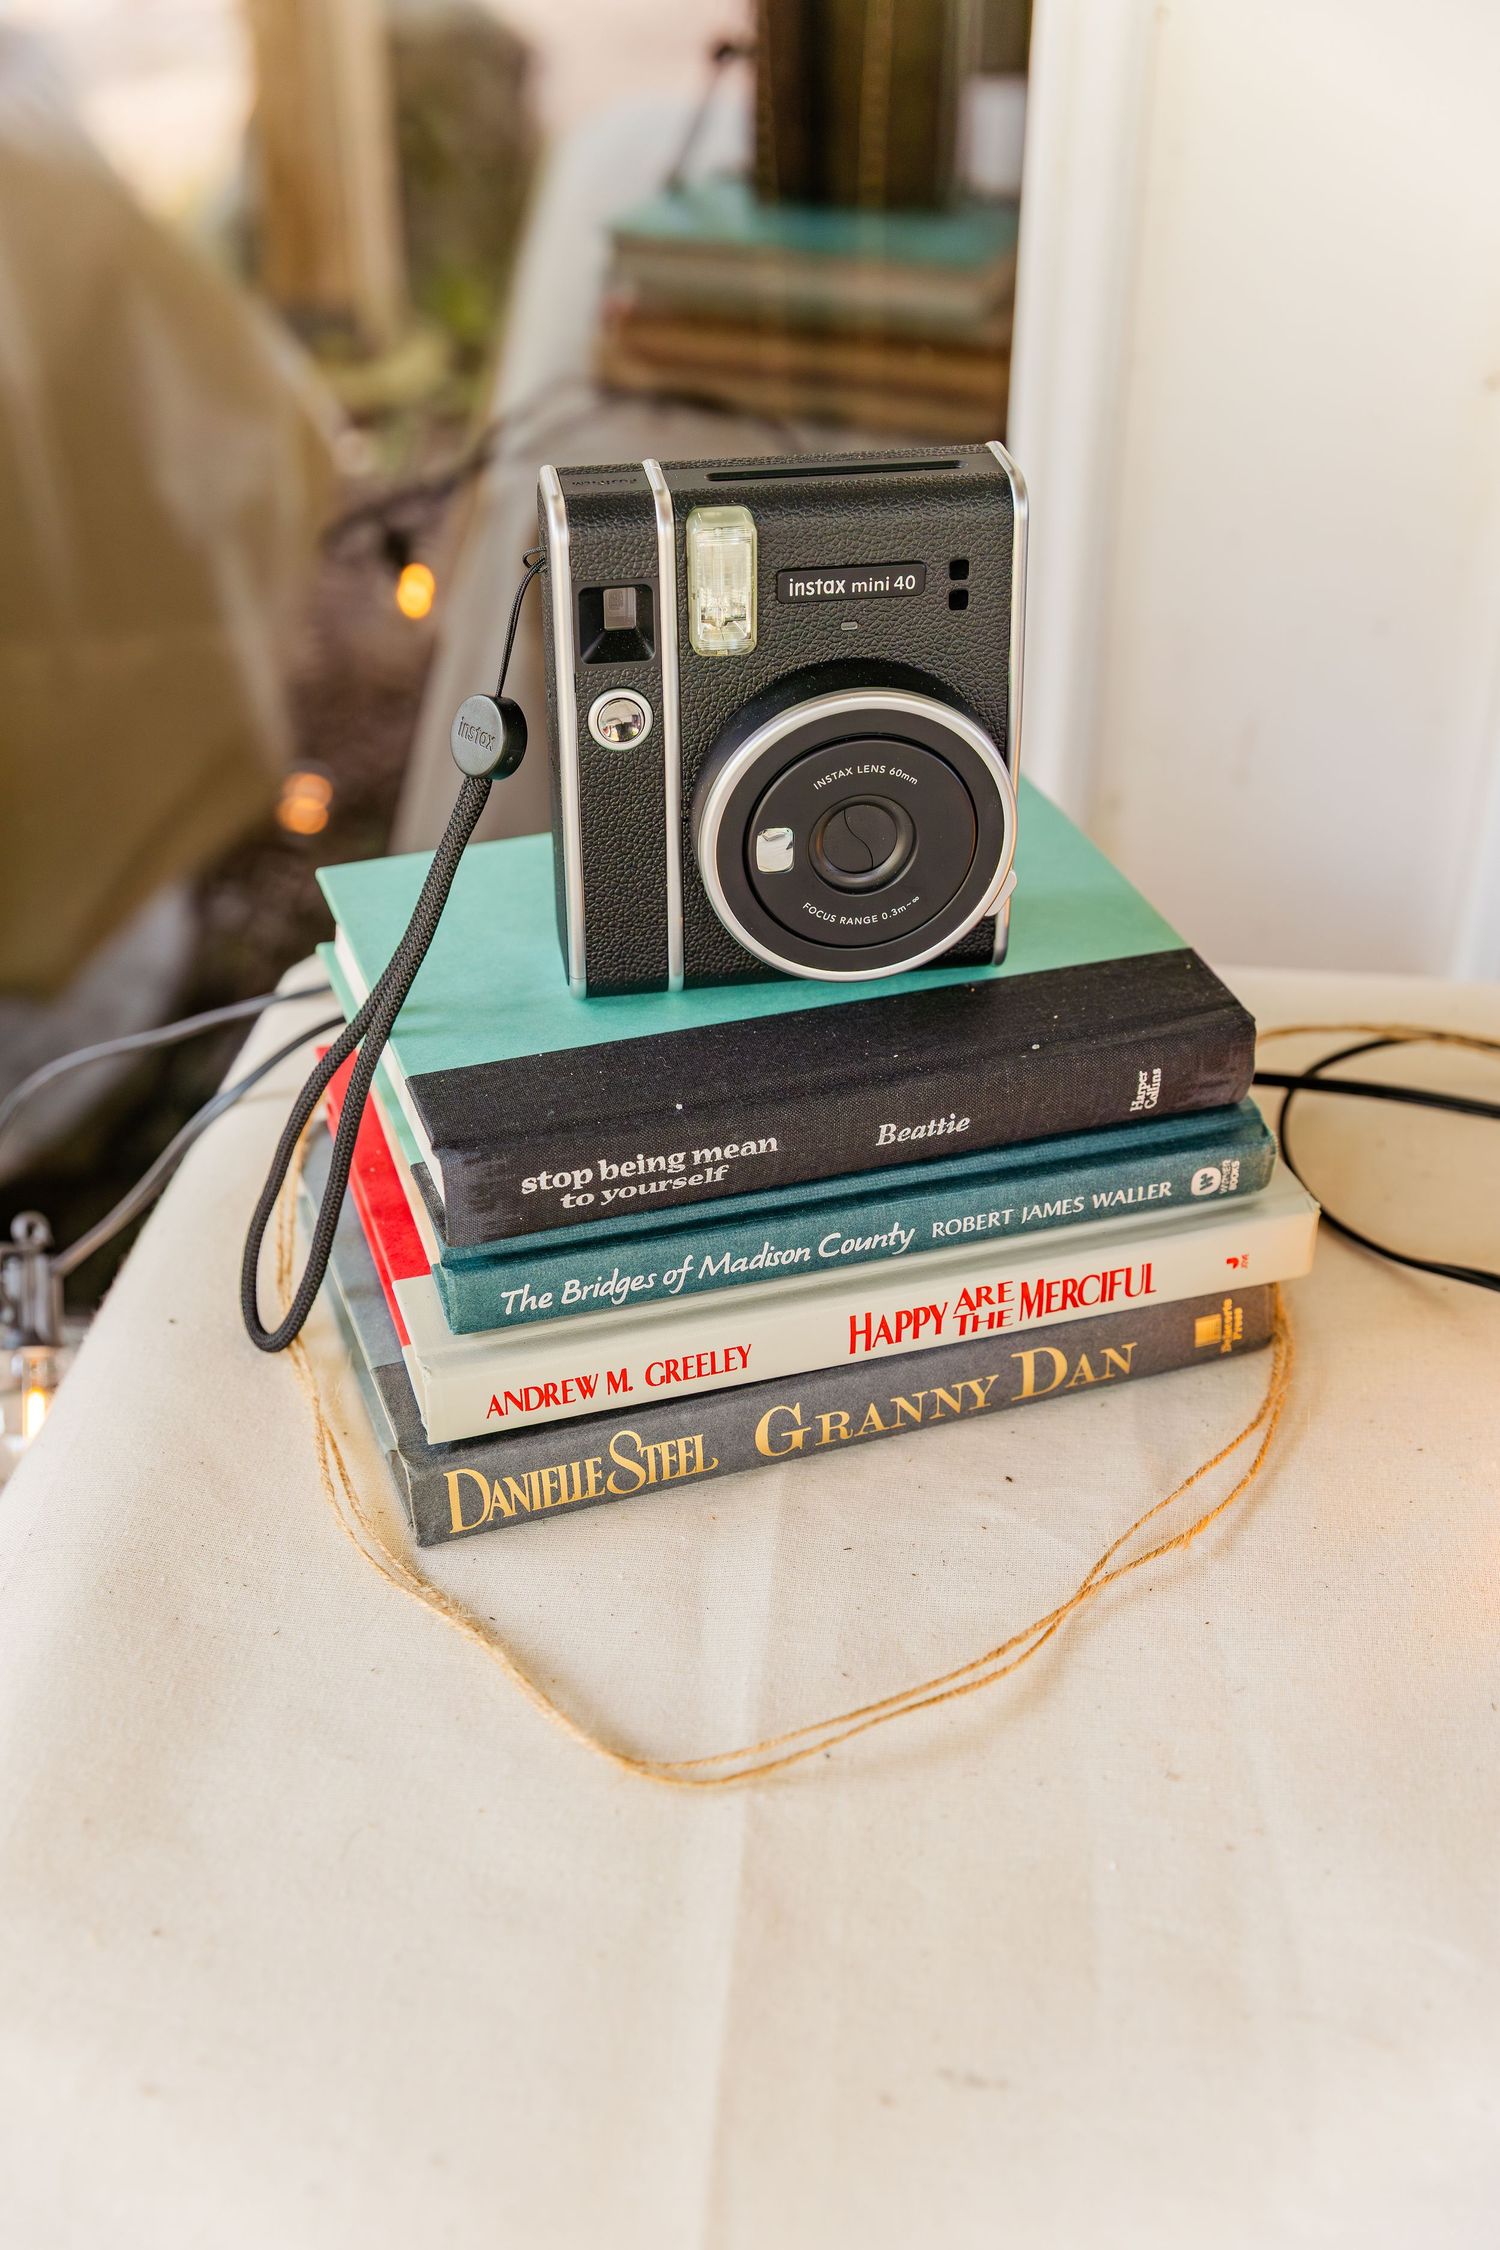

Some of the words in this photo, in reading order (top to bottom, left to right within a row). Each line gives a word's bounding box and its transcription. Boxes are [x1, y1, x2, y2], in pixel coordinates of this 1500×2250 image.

[789, 578, 846, 597] instax
[851, 576, 890, 593] mini
[893, 574, 916, 590] 40
[457, 716, 496, 752] instax
[813, 766, 854, 790] INSTAX
[857, 764, 887, 774] LENS
[889, 767, 918, 785] 60mm
[802, 902, 837, 923] FOCUS
[839, 914, 879, 925] RANGE
[1129, 1070, 1148, 1112] Harper
[1144, 1067, 1162, 1109] Collins
[875, 1112, 971, 1147] Beattie
[520, 1167, 594, 1195] stop
[597, 1152, 687, 1182] being
[691, 1137, 779, 1166] mean
[560, 1191, 595, 1209] to
[600, 1164, 730, 1206] yourself
[931, 1208, 1015, 1239] ROBERT
[1021, 1196, 1085, 1224] JAMES
[1091, 1181, 1173, 1209] WALLER
[500, 1283, 554, 1316] The
[560, 1267, 658, 1305] Bridges
[662, 1254, 697, 1294] of
[698, 1241, 811, 1280] Madison
[818, 1222, 916, 1256] County
[953, 1280, 1016, 1315] ARE
[1018, 1262, 1157, 1323] MERCIFUL
[849, 1301, 948, 1355] HAPPY
[952, 1308, 1015, 1337] THE
[486, 1373, 599, 1419] ANDREW
[606, 1367, 634, 1396] M.
[644, 1343, 752, 1388] GREELEY
[754, 1373, 1000, 1458] GRANNY
[1010, 1341, 1139, 1402] DAN
[442, 1457, 607, 1534] DANIELLE
[606, 1430, 720, 1495] STEEL
